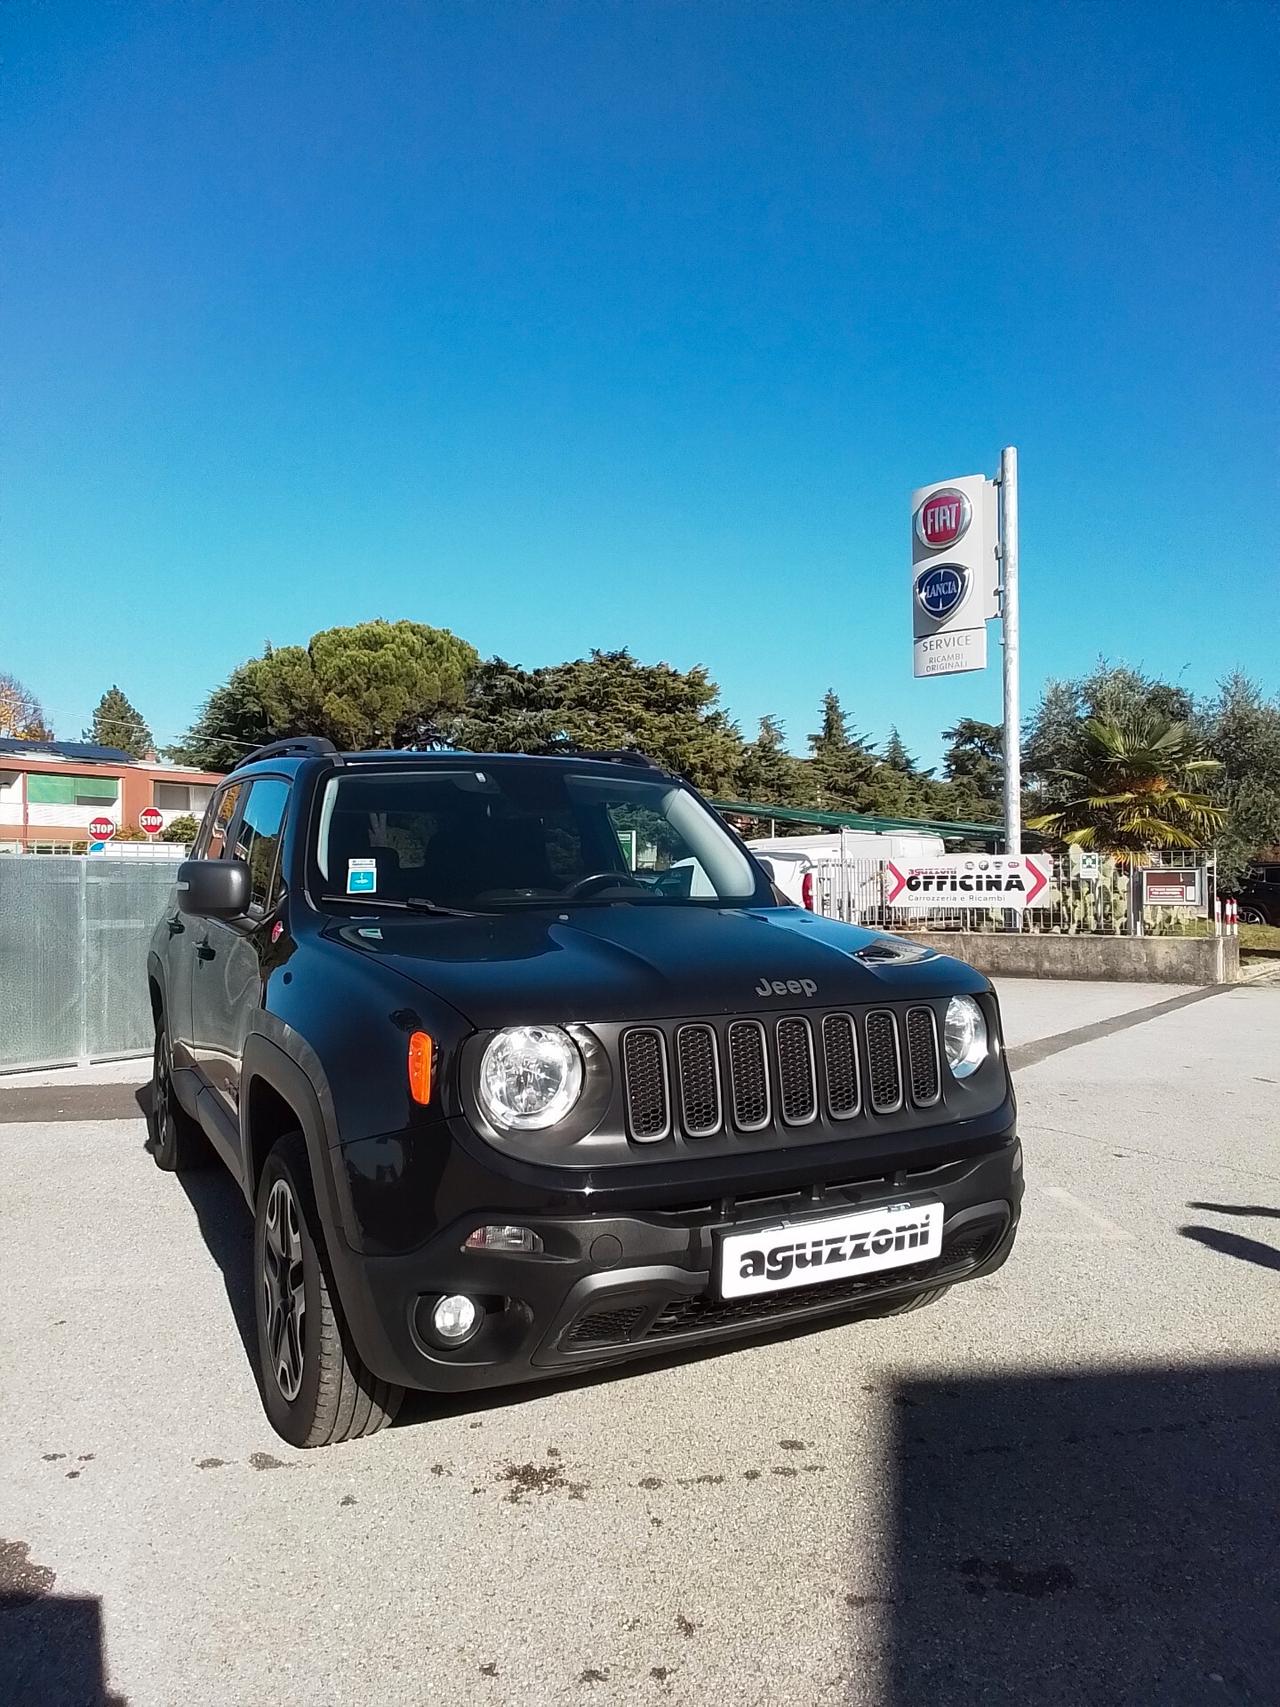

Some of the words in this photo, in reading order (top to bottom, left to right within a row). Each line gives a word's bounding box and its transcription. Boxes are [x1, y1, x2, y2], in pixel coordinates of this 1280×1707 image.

[927, 503, 958, 534] FIAT
[926, 579, 957, 599] LANCIA
[922, 635, 972, 652] SERVICE
[926, 661, 967, 672] ORIGINALI
[929, 653, 964, 664] RICAMBI
[90, 824, 113, 834] STOP
[141, 816, 163, 826] STOP
[906, 874, 1026, 891] OFFICINA
[908, 894, 957, 902] Carrozzeria
[969, 894, 1006, 902] Ricambi
[755, 977, 818, 998] Jeep
[739, 1213, 931, 1281] aguzzoni
